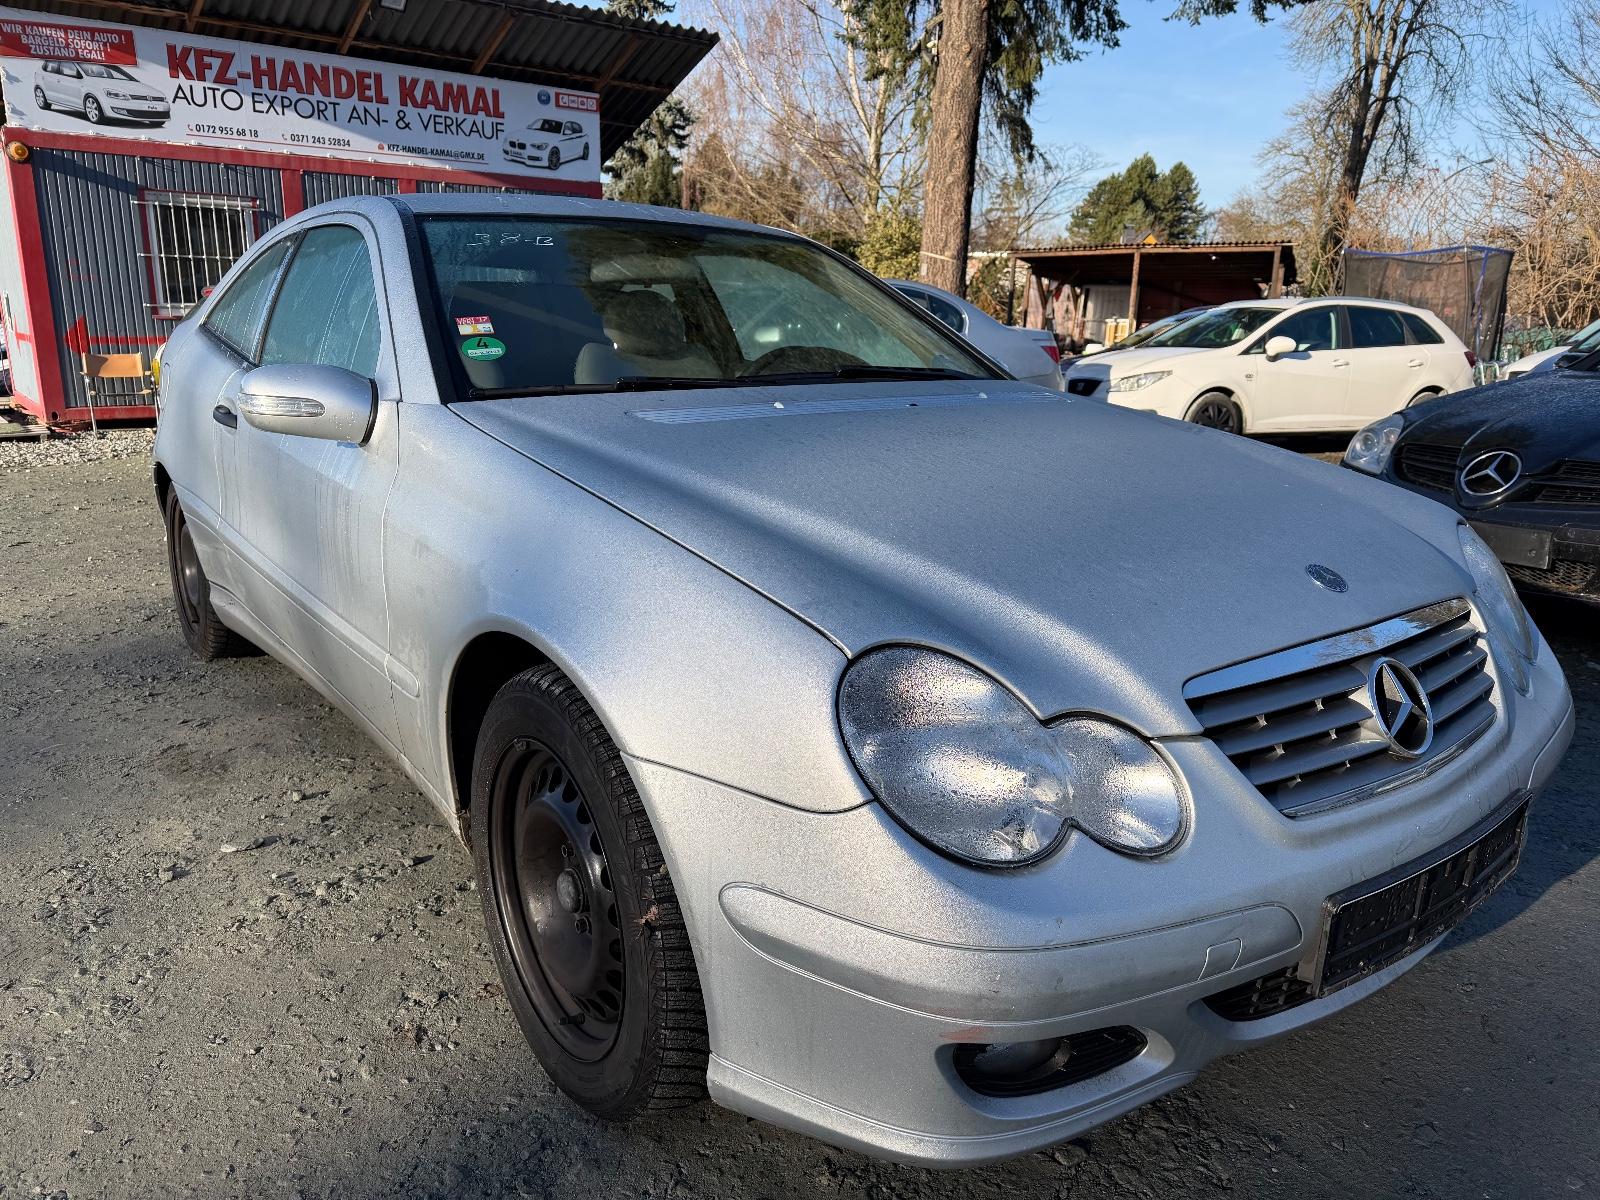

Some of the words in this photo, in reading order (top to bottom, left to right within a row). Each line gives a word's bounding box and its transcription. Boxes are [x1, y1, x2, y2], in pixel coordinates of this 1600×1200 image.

[1, 23, 22, 34] WIR
[25, 25, 65, 38] KAUFEN
[68, 30, 91, 40] DEIN
[94, 33, 119, 43] AUTO
[21, 36, 65, 46] BARGELD
[69, 39, 103, 50] SOFORT
[30, 45, 75, 57] ZUSTAND
[78, 50, 105, 60] EGAL!
[166, 43, 389, 104] KFZ-HANDEL
[399, 75, 505, 118] KAMAL
[172, 84, 243, 111] AUTO
[253, 92, 340, 121] EXPORT
[347, 104, 388, 127] AN-
[396, 109, 412, 131] &
[418, 112, 504, 140] VERKAUF
[195, 123, 217, 134] 0172
[219, 126, 234, 136] 955
[236, 127, 247, 137] 68
[249, 129, 259, 138] 18
[290, 133, 310, 143] 0371
[312, 136, 326, 145] 243
[327, 137, 350, 147] 52834
[387, 144, 484, 160] KFZ-HANDEL-KAMAL@GMX.DE
[477, 337, 489, 348] 4
